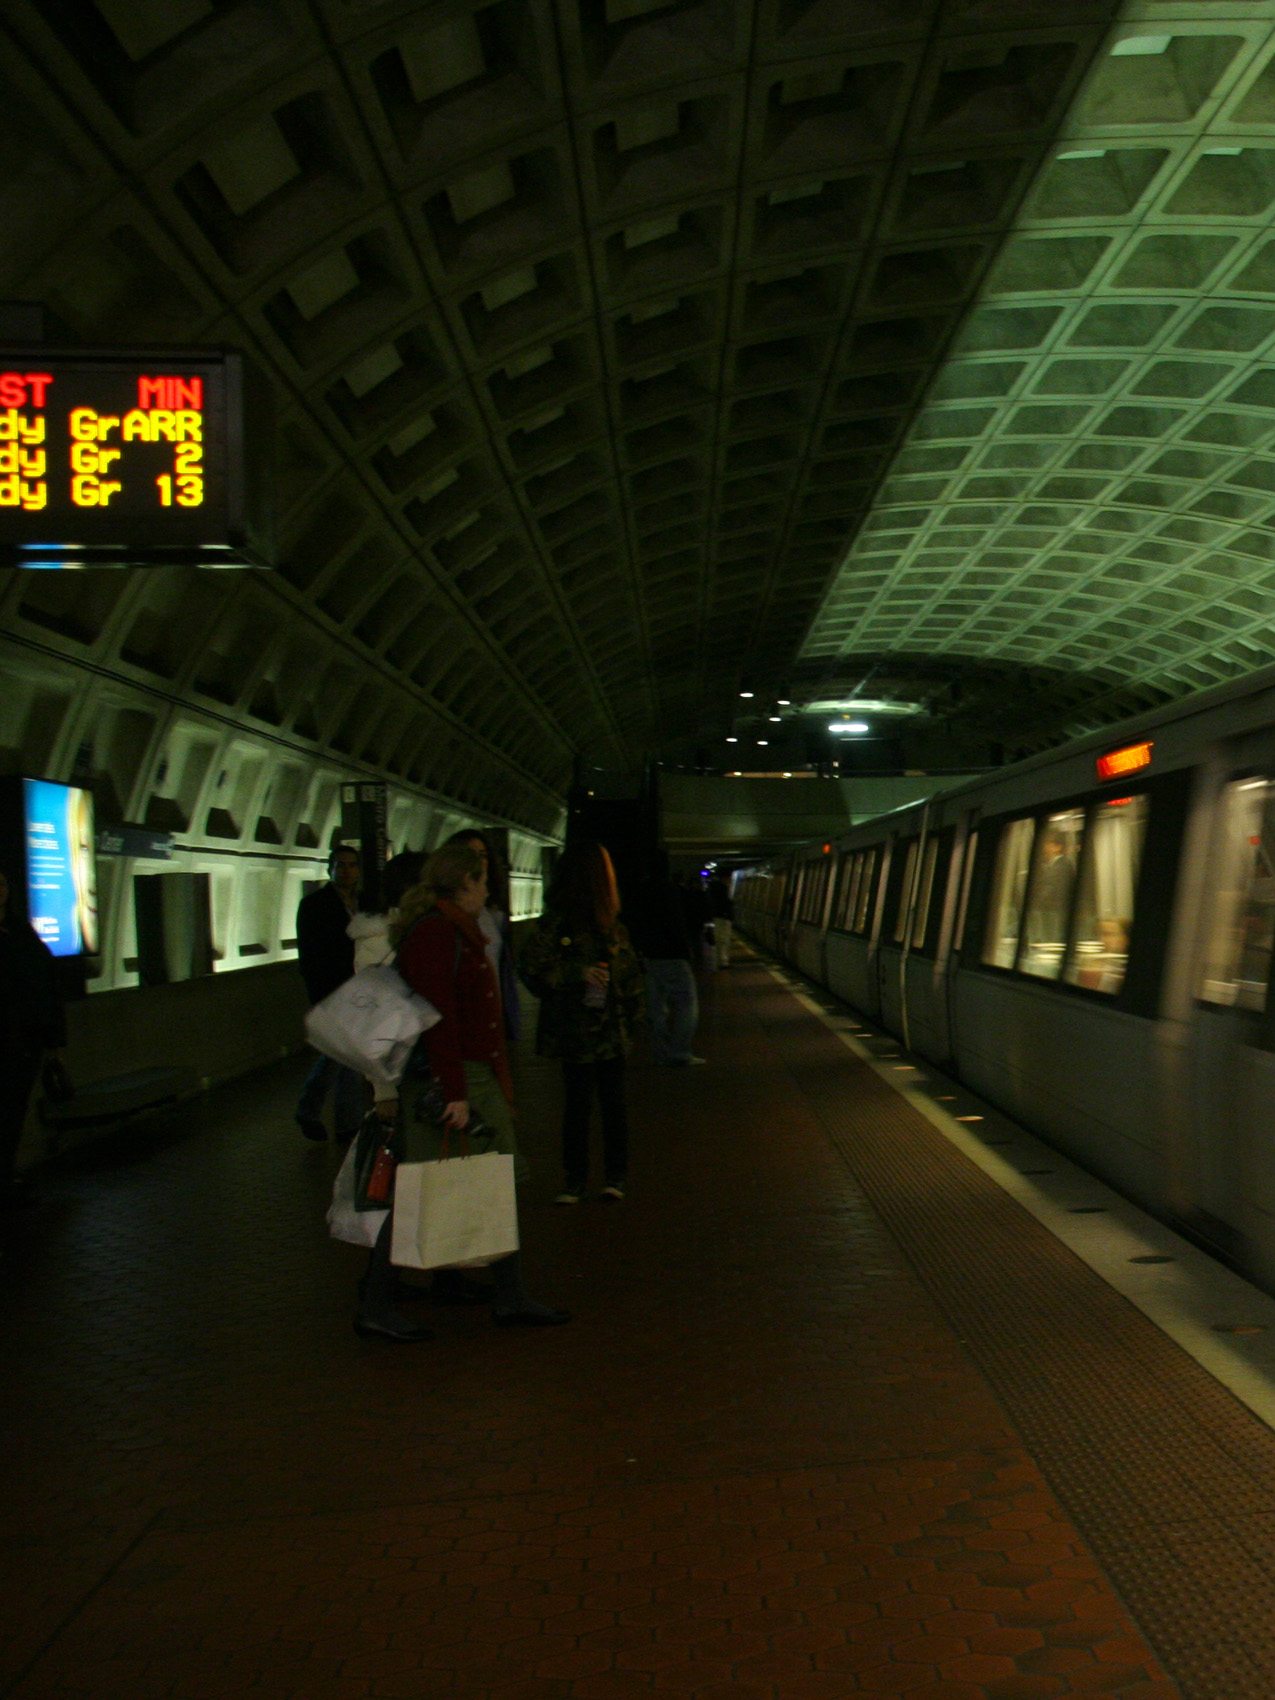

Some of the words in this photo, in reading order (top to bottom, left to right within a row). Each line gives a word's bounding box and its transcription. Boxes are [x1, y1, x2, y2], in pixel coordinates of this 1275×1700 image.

[138, 376, 203, 410] MIN
[70, 407, 121, 441] Gr
[122, 409, 203, 442] ARR
[70, 441, 122, 475] Gr
[175, 442, 203, 475] 2
[71, 474, 122, 507] Gr
[156, 474, 204, 507] 13
